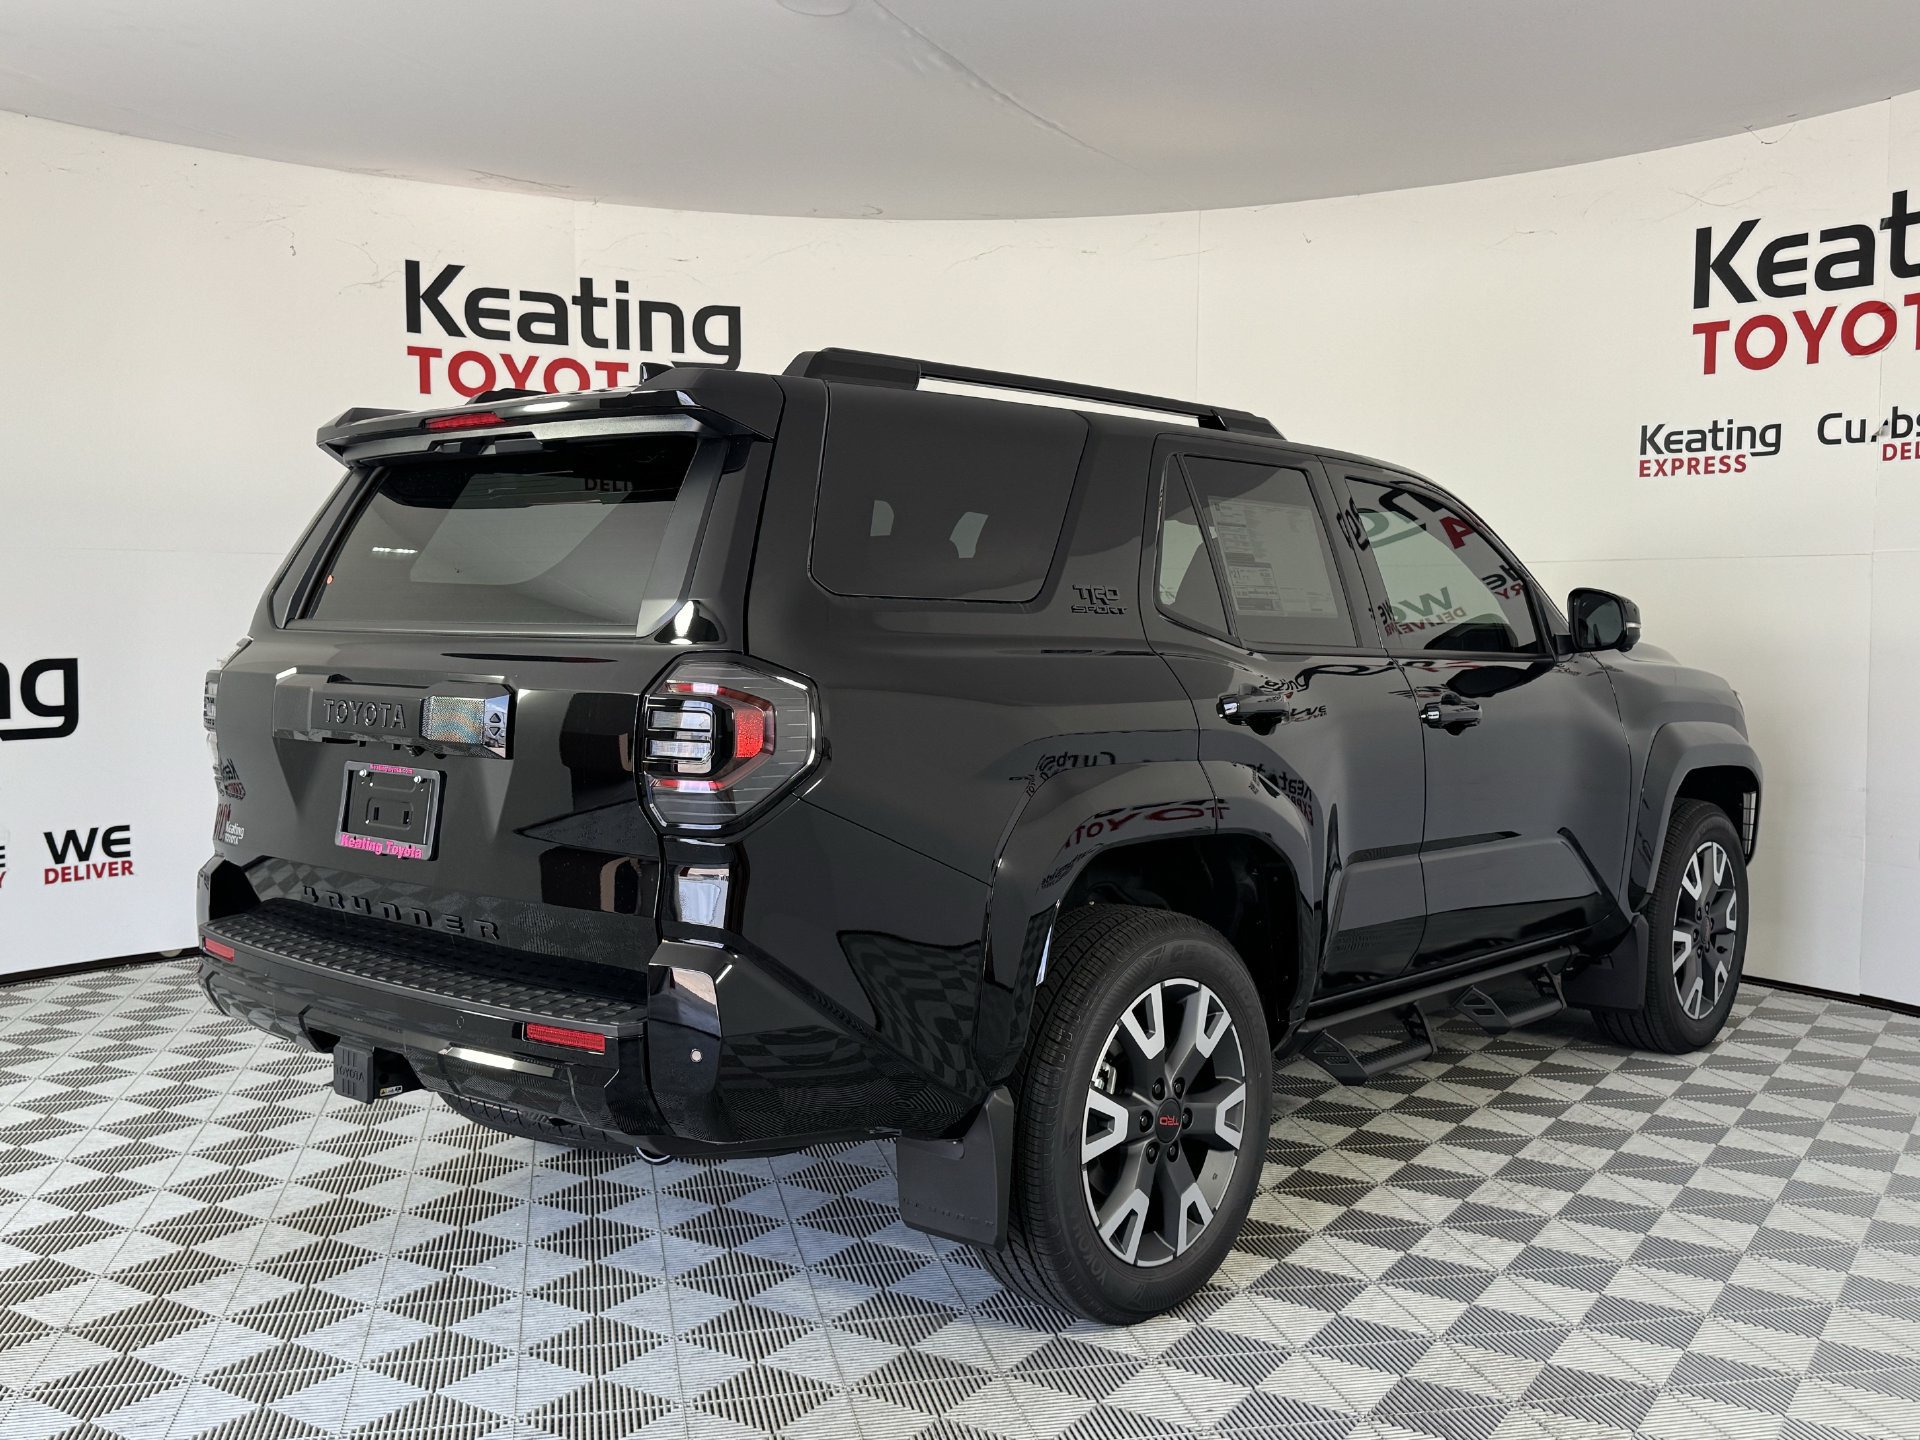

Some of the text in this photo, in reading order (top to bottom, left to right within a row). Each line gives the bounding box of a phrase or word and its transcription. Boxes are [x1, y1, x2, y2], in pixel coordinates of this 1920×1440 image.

[404, 259, 741, 371] Keating
[406, 345, 629, 398] TOYOT
[1639, 418, 1782, 457] Keating
[1638, 454, 1747, 478] EXPRESS
[1072, 584, 1119, 605] TRD
[323, 699, 406, 730] TOYOTA
[43, 824, 131, 865] WE
[341, 834, 423, 859] Keating Toyota
[44, 860, 134, 885] DELIVER
[336, 1064, 365, 1083] TOYOTA
[1159, 1115, 1180, 1126] TRD
